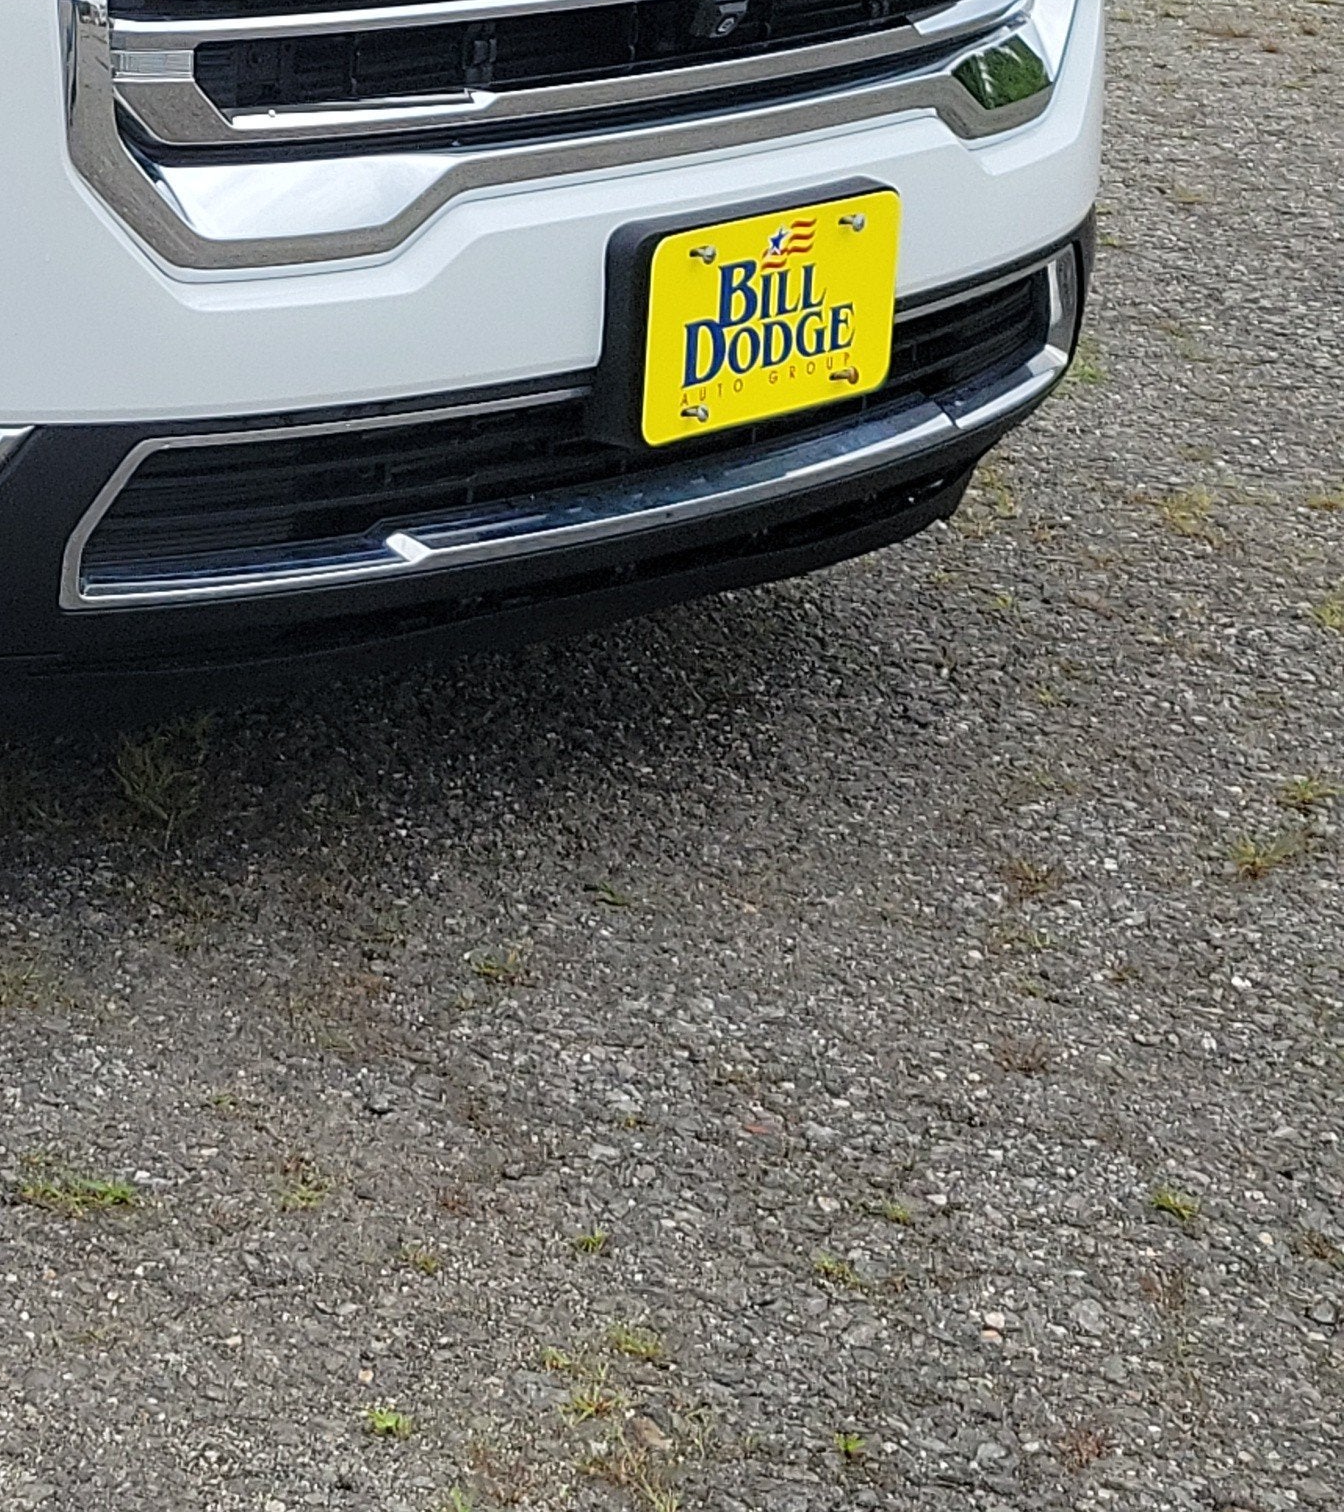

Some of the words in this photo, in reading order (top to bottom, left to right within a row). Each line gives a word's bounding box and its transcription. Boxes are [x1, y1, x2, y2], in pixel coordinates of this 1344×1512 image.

[718, 259, 827, 329] BILL
[680, 377, 745, 407] AUTO
[768, 352, 852, 385] GROUP
[681, 302, 856, 389] DODGE
